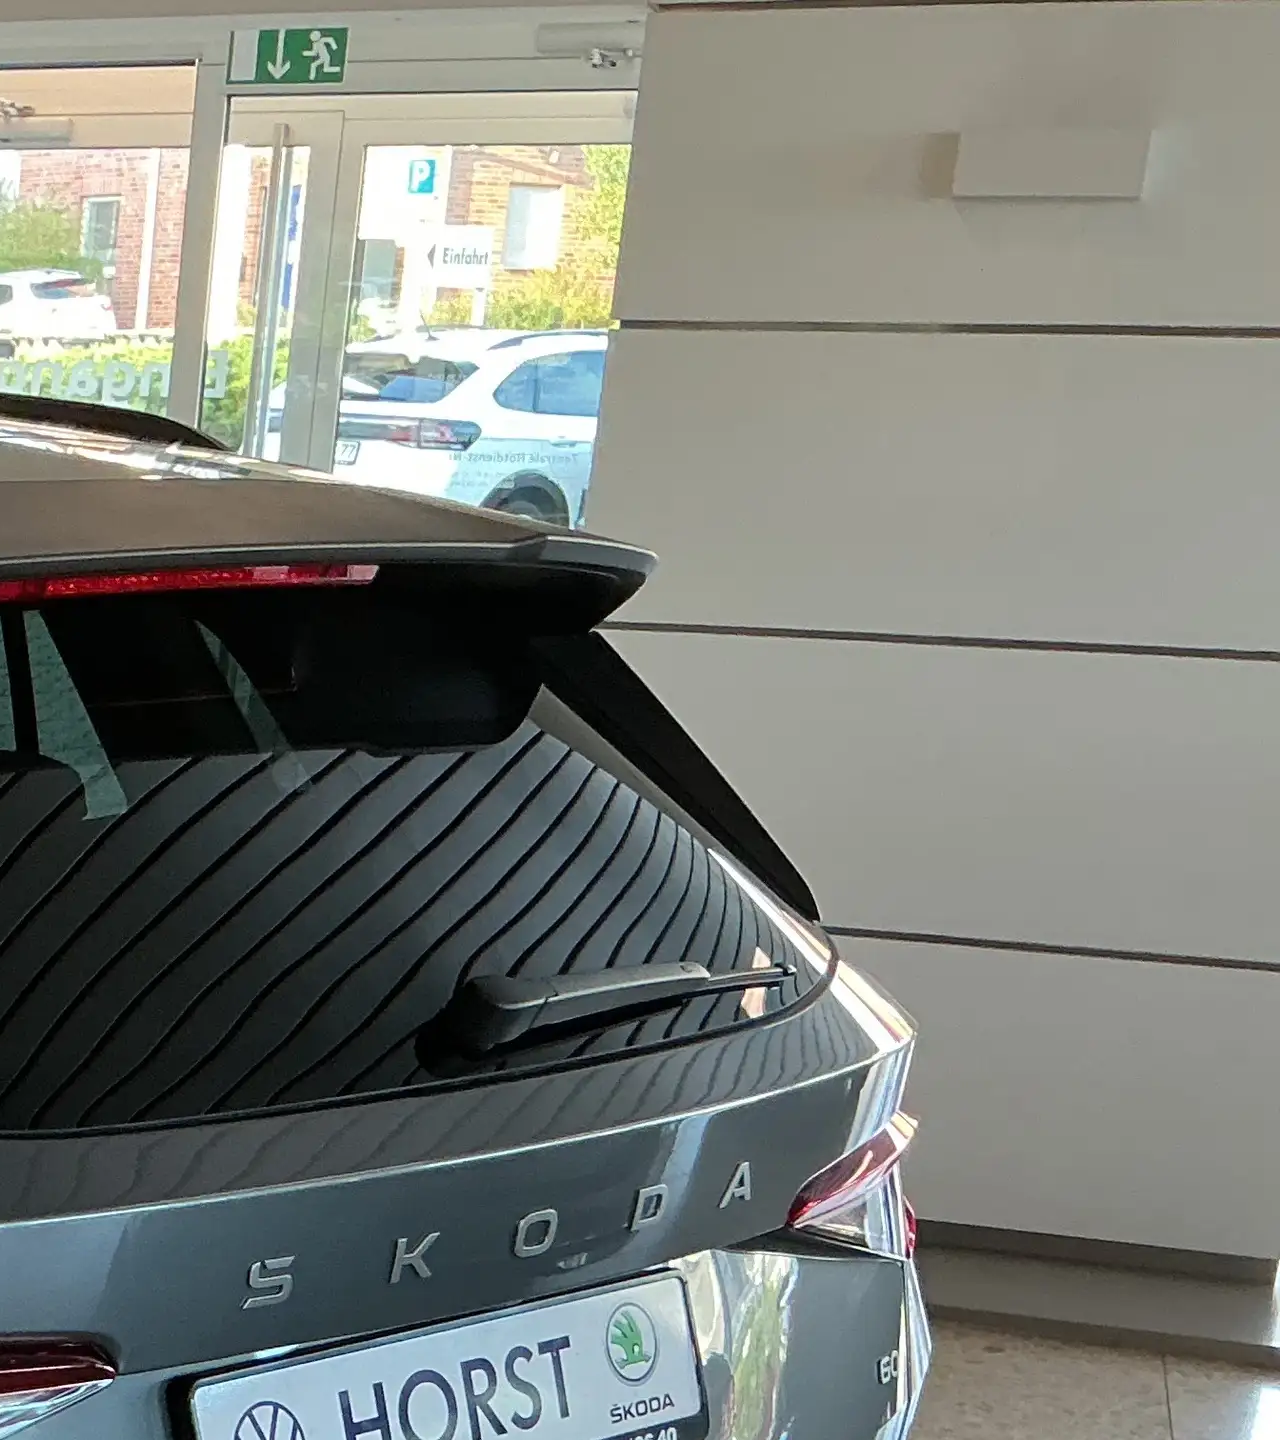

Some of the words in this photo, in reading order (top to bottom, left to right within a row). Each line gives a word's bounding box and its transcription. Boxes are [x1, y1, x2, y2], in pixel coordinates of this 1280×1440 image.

[410, 160, 432, 192] P
[442, 247, 490, 266] Einfahrt
[609, 1393, 676, 1424] ŠKODA
